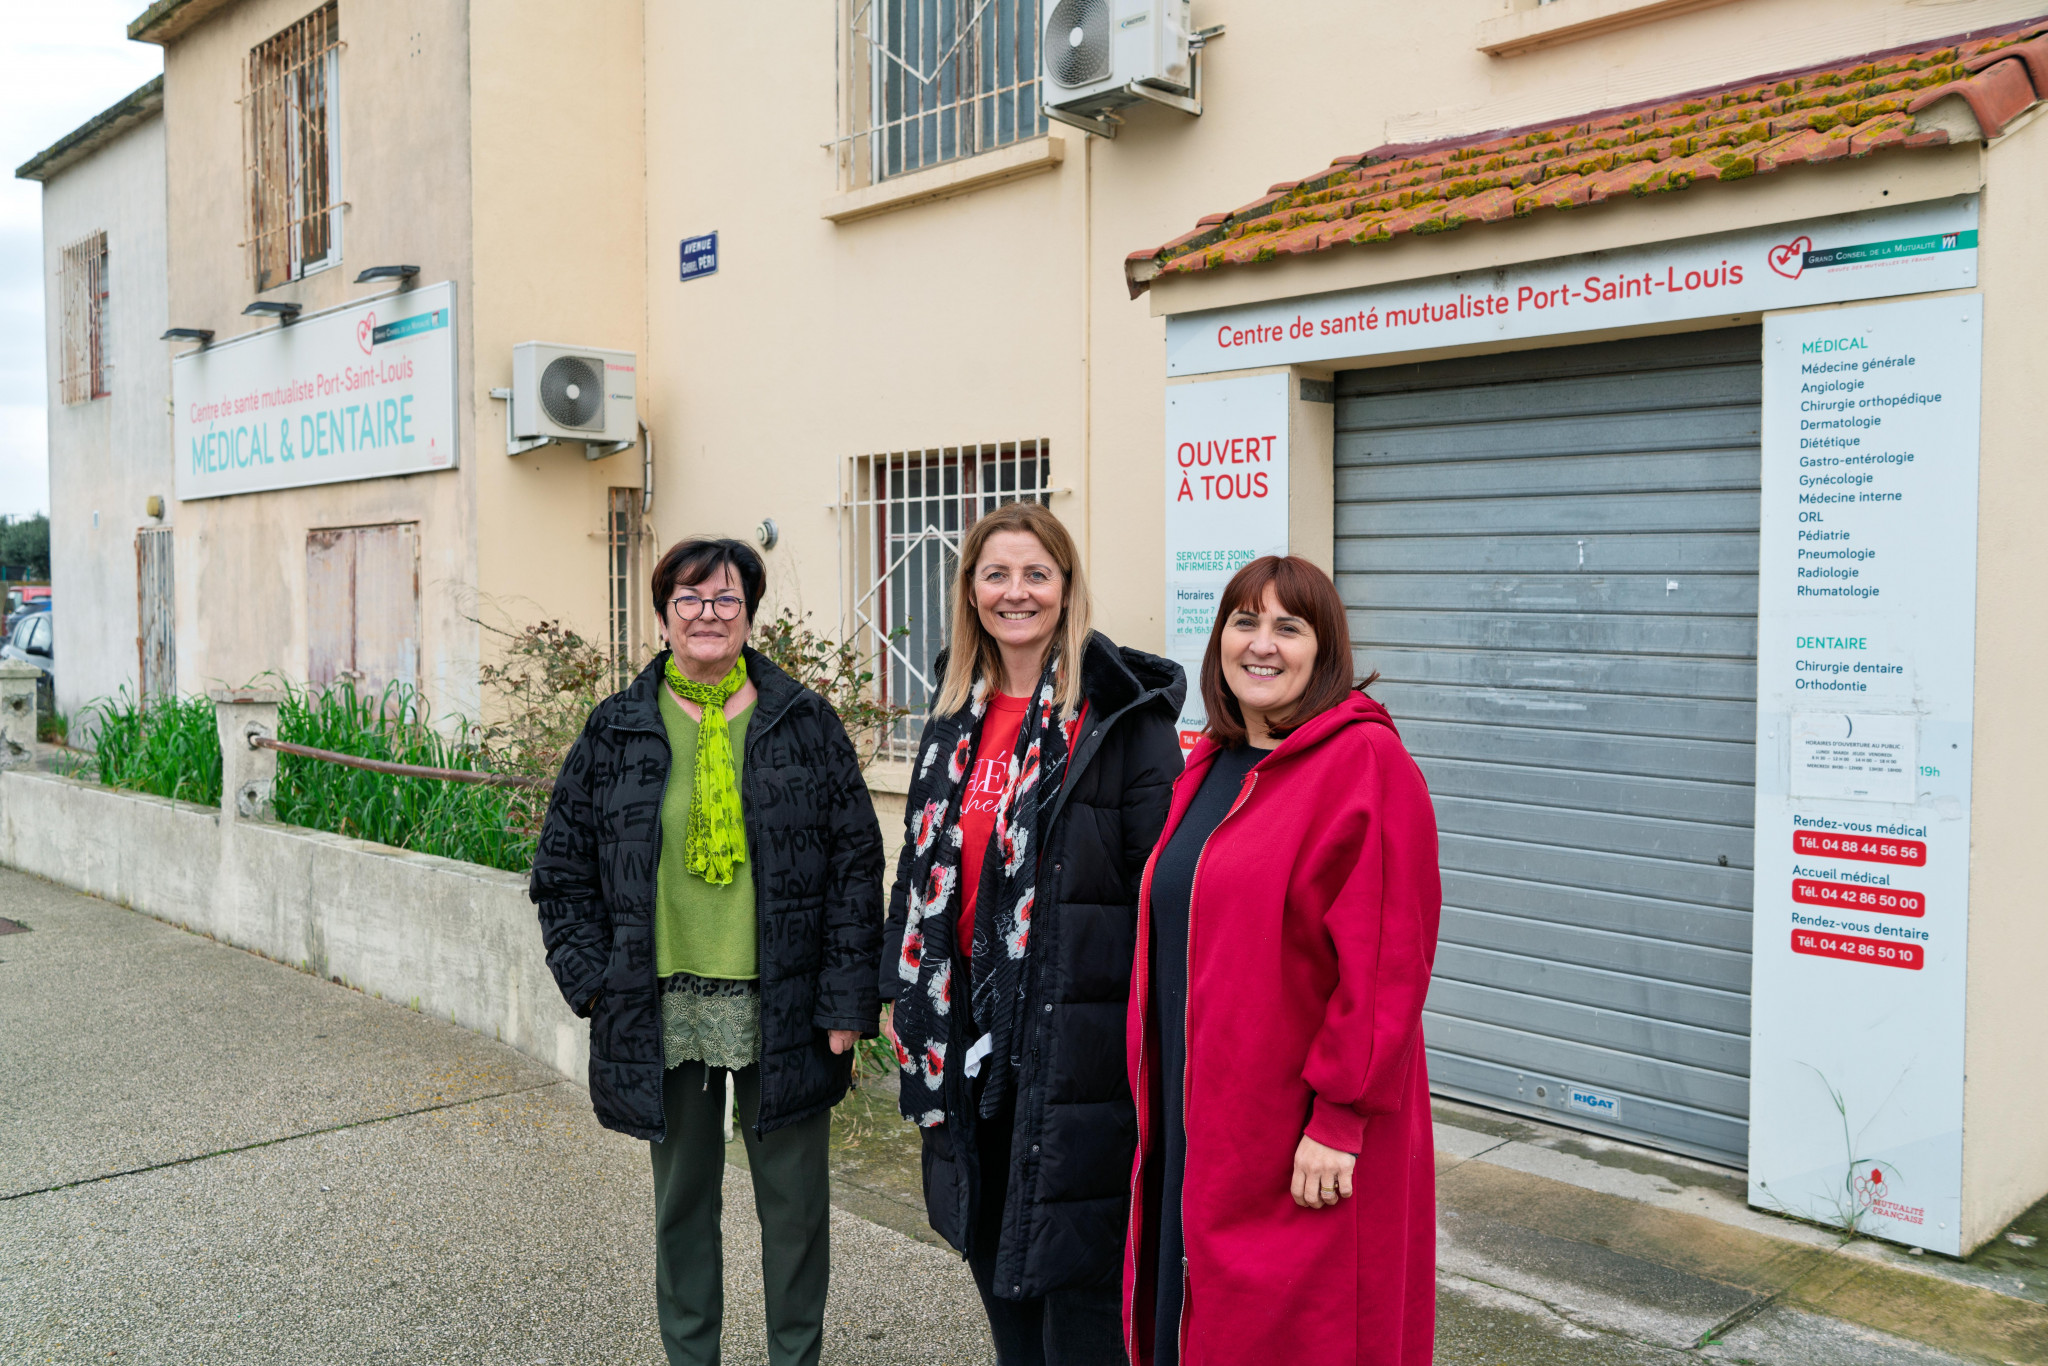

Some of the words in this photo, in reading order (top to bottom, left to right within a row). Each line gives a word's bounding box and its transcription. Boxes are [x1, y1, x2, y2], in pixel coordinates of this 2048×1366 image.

[684, 238, 712, 255] AVENUE
[1808, 255, 1833, 264] GRAND
[1835, 251, 1867, 260] CONSEIL
[1869, 248, 1880, 256] DE
[1894, 241, 1936, 253] MUTUALITÉ
[698, 254, 715, 270] PÉRI
[1911, 255, 1935, 263] FRANCE
[1217, 323, 1283, 349] Centre
[1289, 315, 1314, 339] de
[1320, 306, 1379, 336] santé
[1385, 293, 1509, 329] mutualiste
[1517, 260, 1744, 312] Port-Saint-Louis
[1802, 336, 1869, 354] MÉDICAL
[1801, 361, 1858, 375] Médecine
[1862, 354, 1916, 372] générale
[190, 400, 219, 424] Centre
[220, 394, 232, 418] de
[234, 389, 259, 415] santé
[261, 379, 314, 409] mutualiste
[316, 355, 414, 397] Port-Saint-Louis
[1801, 379, 1865, 395] Angiologie
[1800, 398, 1855, 412] Chirurgie
[1858, 392, 1942, 408] orthopédique
[1800, 415, 1881, 430] Dermatologie
[191, 421, 275, 476] MÉDICAL
[280, 417, 295, 463] &
[301, 394, 415, 459] DENTAIRE
[1800, 436, 1860, 449] Diététique
[1177, 435, 1277, 468] OUVERT
[1799, 451, 1915, 467] Gastro-entérologie
[1177, 470, 1194, 502] À
[1200, 471, 1269, 501] TOUS
[1799, 473, 1874, 488] Gynécologie
[1798, 492, 1856, 504] Médecine
[1859, 491, 1902, 502] interne
[1798, 511, 1824, 523] ORL
[1798, 530, 1850, 541] Pédiatrie
[1176, 550, 1212, 561] SERVICE
[1214, 550, 1225, 560] DE
[1227, 549, 1256, 560] SOINS
[1797, 548, 1876, 561] Pneumologie
[1176, 561, 1224, 571] INFIRMIERS
[1797, 566, 1859, 580] Radiologie
[1177, 589, 1214, 600] Horaires
[1797, 585, 1880, 599] Rhumatologie
[1177, 606, 1181, 614] 7
[1182, 607, 1198, 615] jours
[1211, 606, 1215, 614] 7
[1177, 616, 1185, 624] de
[1186, 616, 1204, 624] 7h30
[1205, 616, 1209, 624] à
[1184, 626, 1193, 634] de
[1796, 636, 1868, 650] DENTAIRE
[1795, 660, 1850, 674] Chirurgie
[1853, 661, 1904, 674] dentaire
[1795, 678, 1867, 692] Orthodontie
[1181, 716, 1206, 726] Accueil
[1832, 740, 1870, 748] D'OUVERTURE
[1920, 766, 1940, 776] 19h
[1793, 814, 1873, 832] Rendez-vous
[1876, 823, 1928, 838] médical
[1800, 836, 1819, 849] Tél.
[1822, 839, 1838, 851] 04
[1841, 841, 1858, 853] 88
[1861, 843, 1878, 855] 44
[1880, 845, 1897, 857] 56
[1900, 847, 1918, 859] 56
[1792, 865, 1837, 880] Accueil
[1841, 872, 1890, 886] médical
[1799, 885, 1818, 898] Tél.
[1821, 887, 1838, 900] 04
[1840, 890, 1857, 902] 42
[1859, 892, 1876, 904] 86
[1879, 895, 1897, 907] 50
[1900, 897, 1918, 910] 00
[1791, 912, 1870, 933] Rendez-vous
[1874, 923, 1929, 941] dentaire
[1797, 935, 1817, 948] Tél.
[1820, 938, 1836, 951] 04
[1839, 941, 1856, 954] 42
[1858, 944, 1875, 956] 86
[1878, 947, 1896, 959] 50
[1898, 949, 1914, 962] 10
[1573, 1093, 1615, 1109] RIGAT
[1873, 1198, 1925, 1217] MUTUALITÉ
[1872, 1206, 1924, 1225] FRANÇAISE
